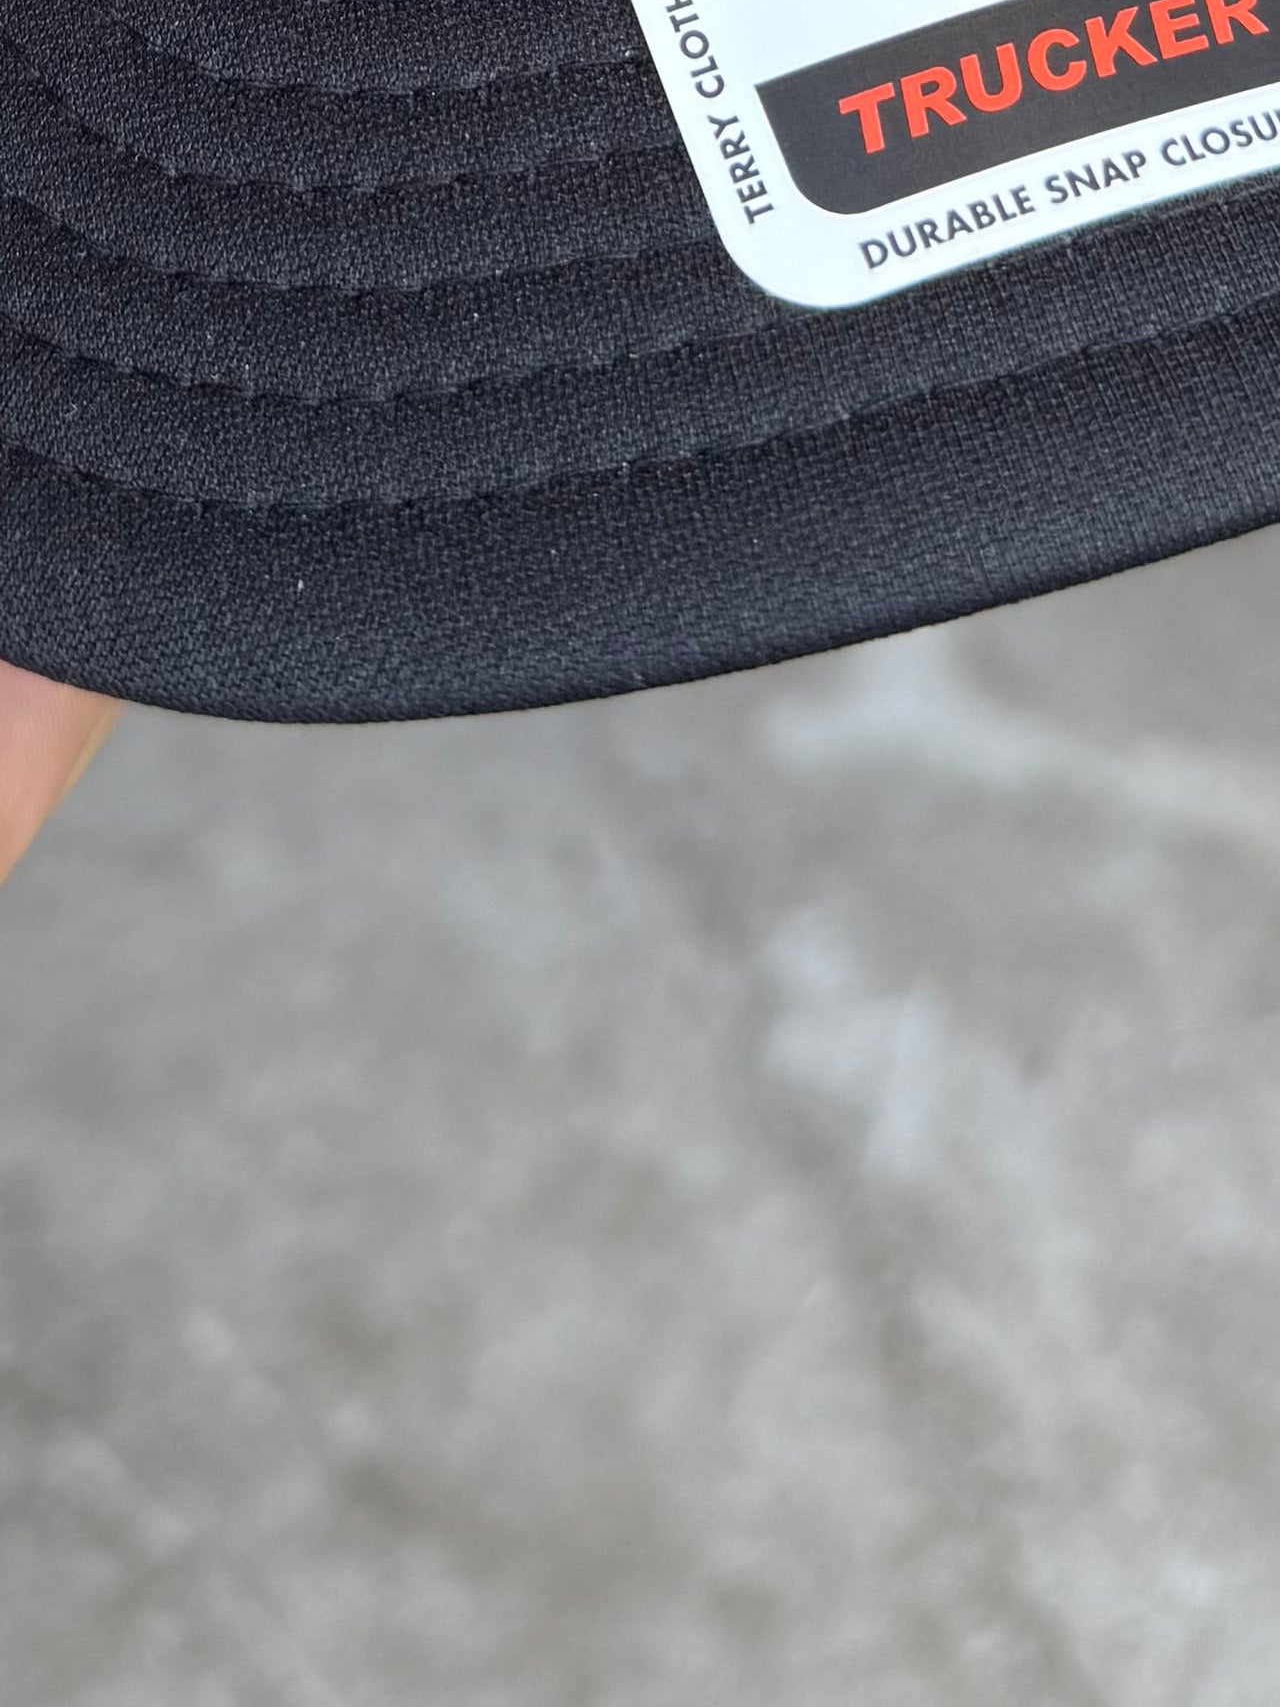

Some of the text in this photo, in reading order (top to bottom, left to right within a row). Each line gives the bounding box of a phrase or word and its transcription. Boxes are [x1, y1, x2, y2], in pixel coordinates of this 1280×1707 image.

[712, 115, 778, 224] TERRY
[860, 186, 1036, 271] DURABLE
[1045, 151, 1146, 205] SNAP
